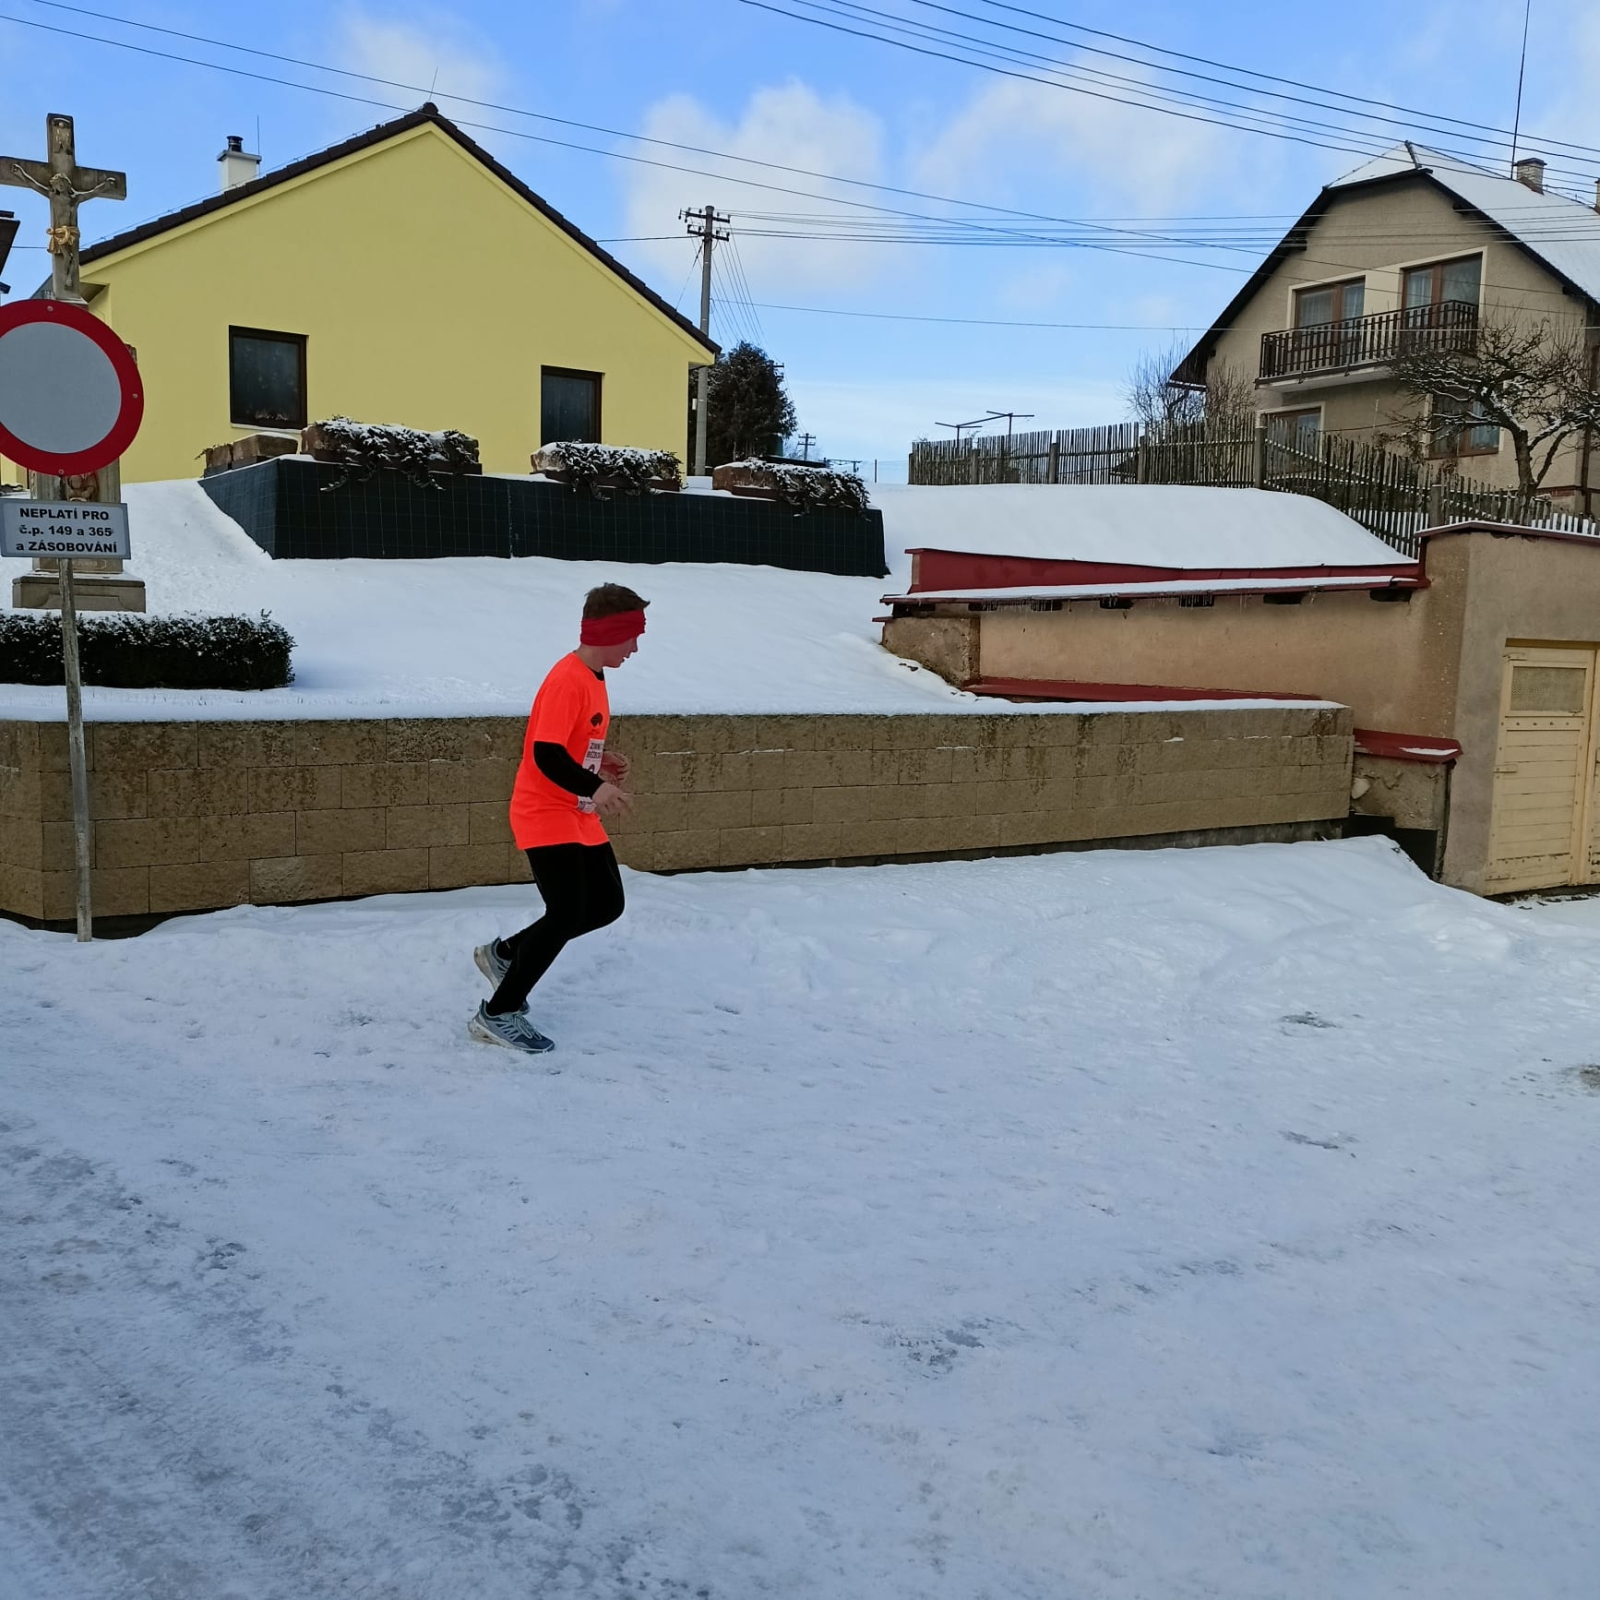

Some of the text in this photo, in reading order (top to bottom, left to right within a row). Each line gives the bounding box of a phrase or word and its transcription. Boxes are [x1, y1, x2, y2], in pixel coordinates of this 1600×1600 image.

[20, 508, 109, 520] NEPLATÍ PRO
[19, 524, 113, 536] č.p. 149 a 365
[16, 540, 117, 553] a ZÁSOBOVÁNÍ
